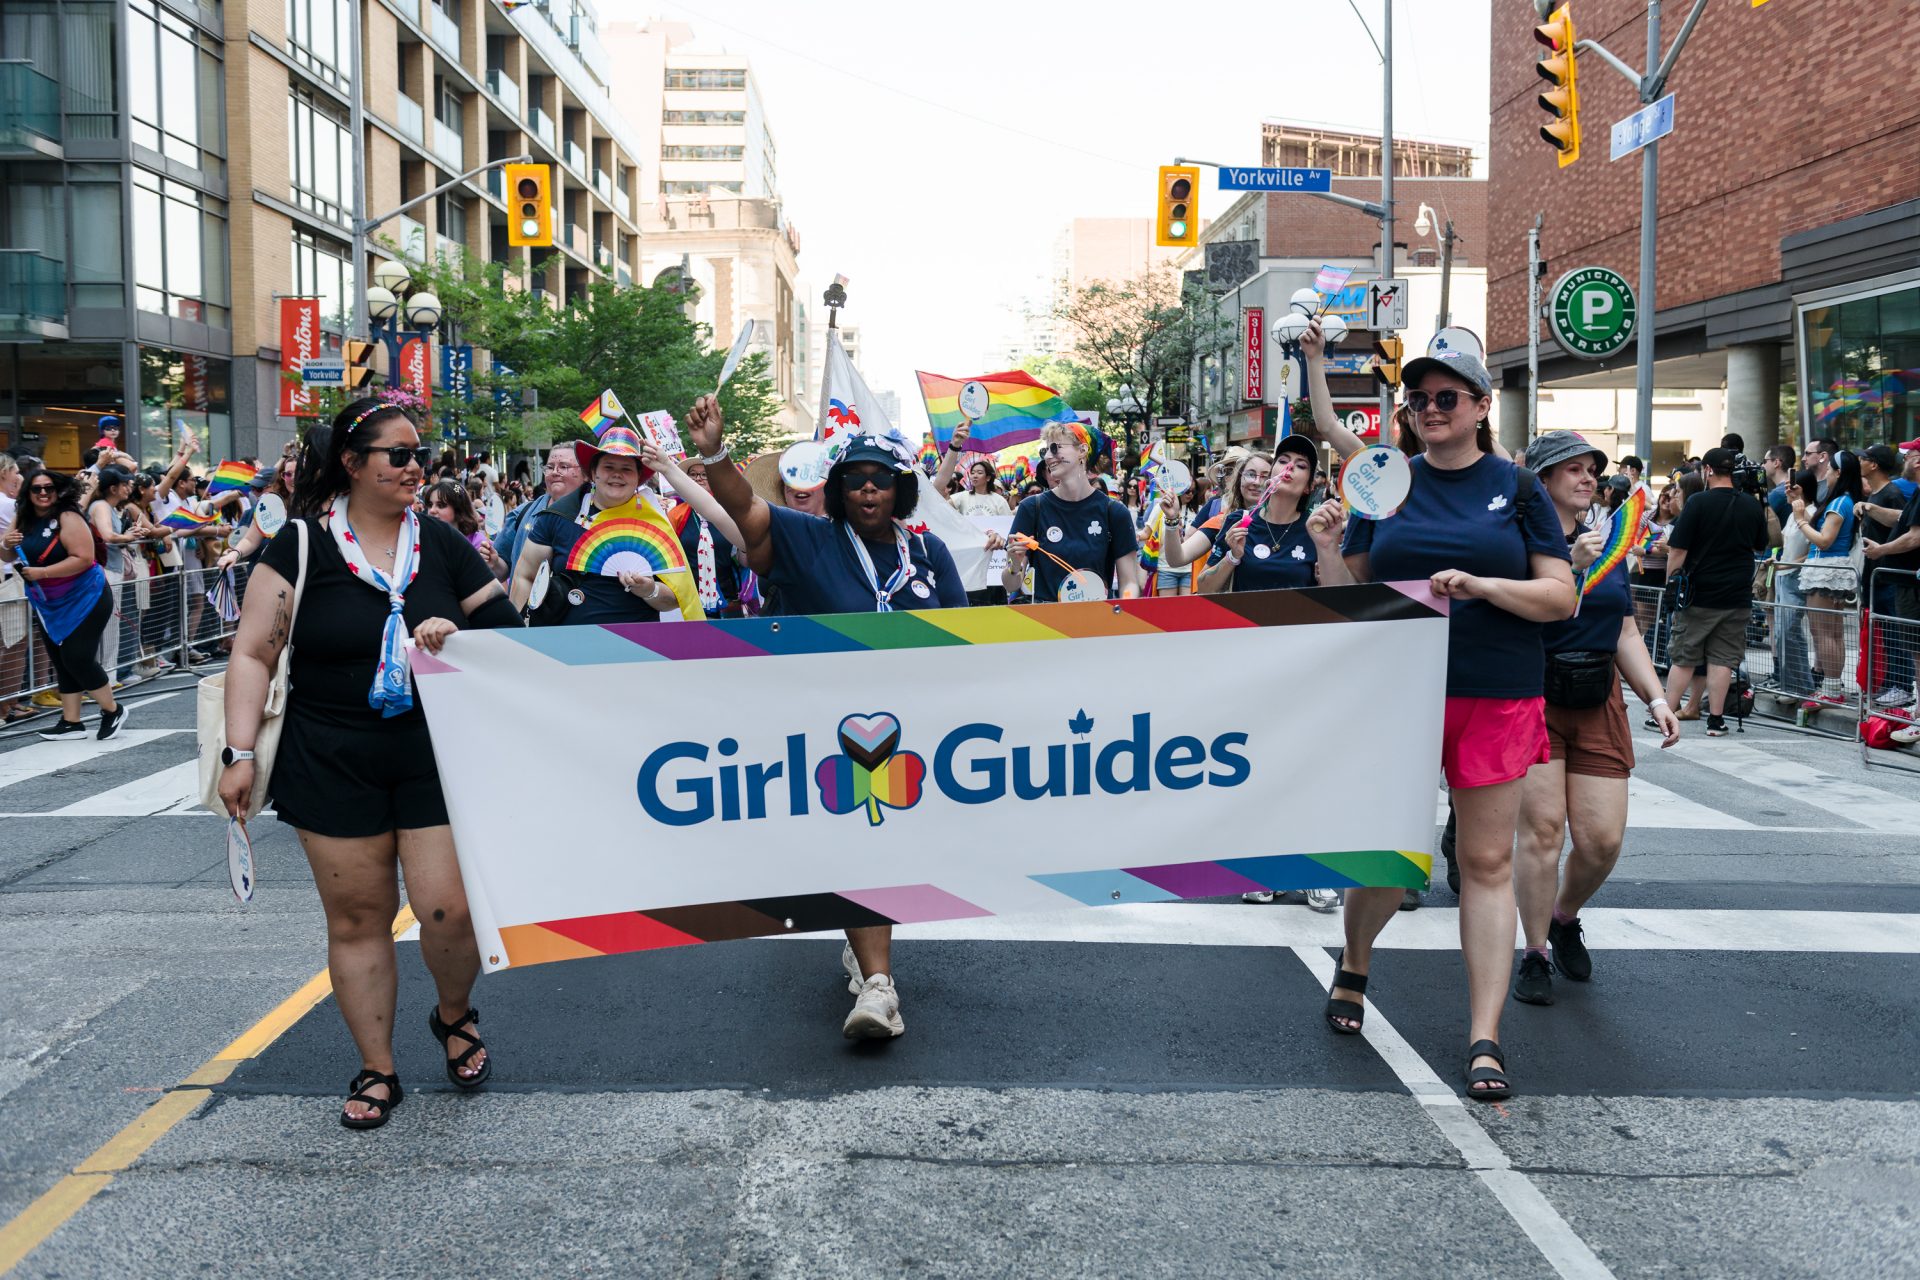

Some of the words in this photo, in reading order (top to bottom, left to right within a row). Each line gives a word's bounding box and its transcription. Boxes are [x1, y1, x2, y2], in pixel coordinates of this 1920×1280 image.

[1622, 115, 1651, 145] Yonge
[1229, 169, 1304, 187] Yorkville
[1309, 170, 1321, 180] Av
[1560, 271, 1631, 302] MUNICIPAL
[1582, 290, 1613, 324] P
[1559, 318, 1632, 351] PARKING
[309, 370, 339, 379] Yorkville
[408, 343, 424, 397] ortons
[1360, 463, 1380, 485] Girl
[1347, 472, 1379, 512] Guides
[261, 511, 271, 521] Girl
[1067, 590, 1085, 602] Girl
[636, 732, 809, 827] Girl
[933, 708, 1251, 804] Guides
